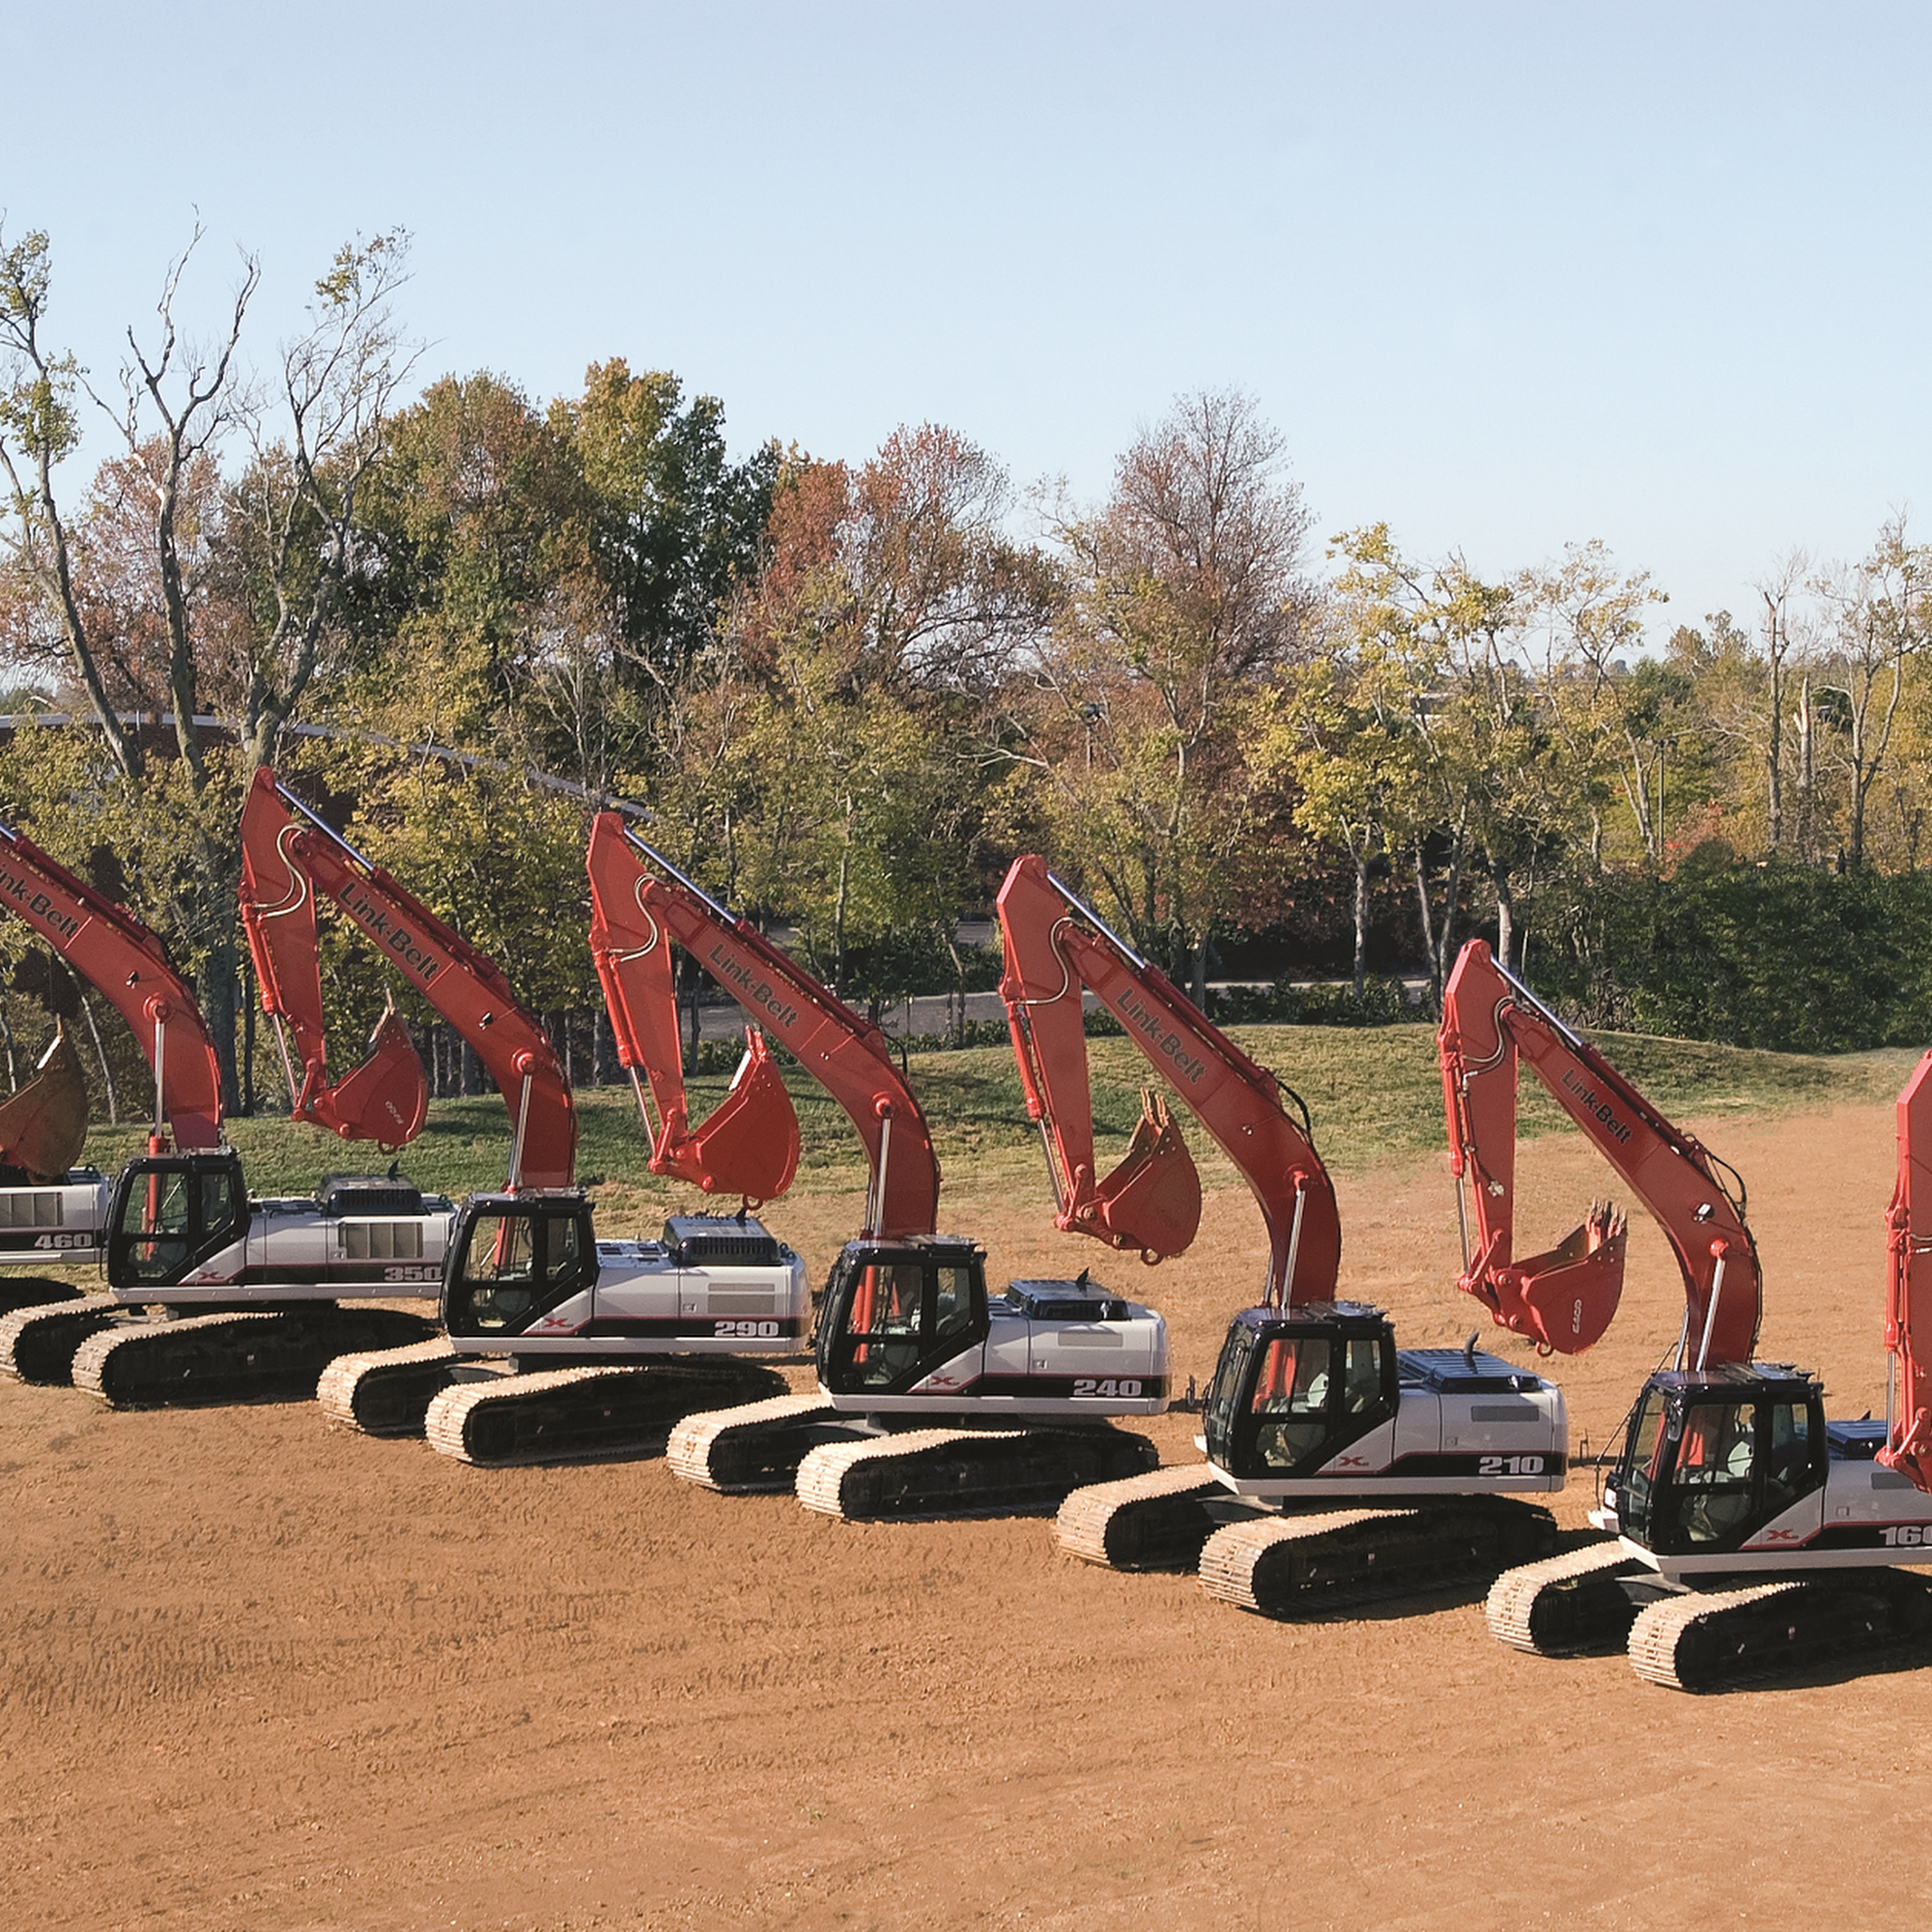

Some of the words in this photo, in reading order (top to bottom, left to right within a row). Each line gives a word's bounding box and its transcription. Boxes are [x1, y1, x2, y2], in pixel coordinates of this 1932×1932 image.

[339, 881, 440, 980] Link-Belt
[709, 943, 797, 1028] Link-Belt
[1116, 987, 1206, 1083] Link-Belt
[1561, 1068, 1633, 1145] Link-Belt
[34, 1234, 93, 1250] 460
[384, 1265, 443, 1282] 350
[714, 1321, 780, 1337] 290
[1072, 1378, 1143, 1397] 240
[1478, 1456, 1545, 1474] 210
